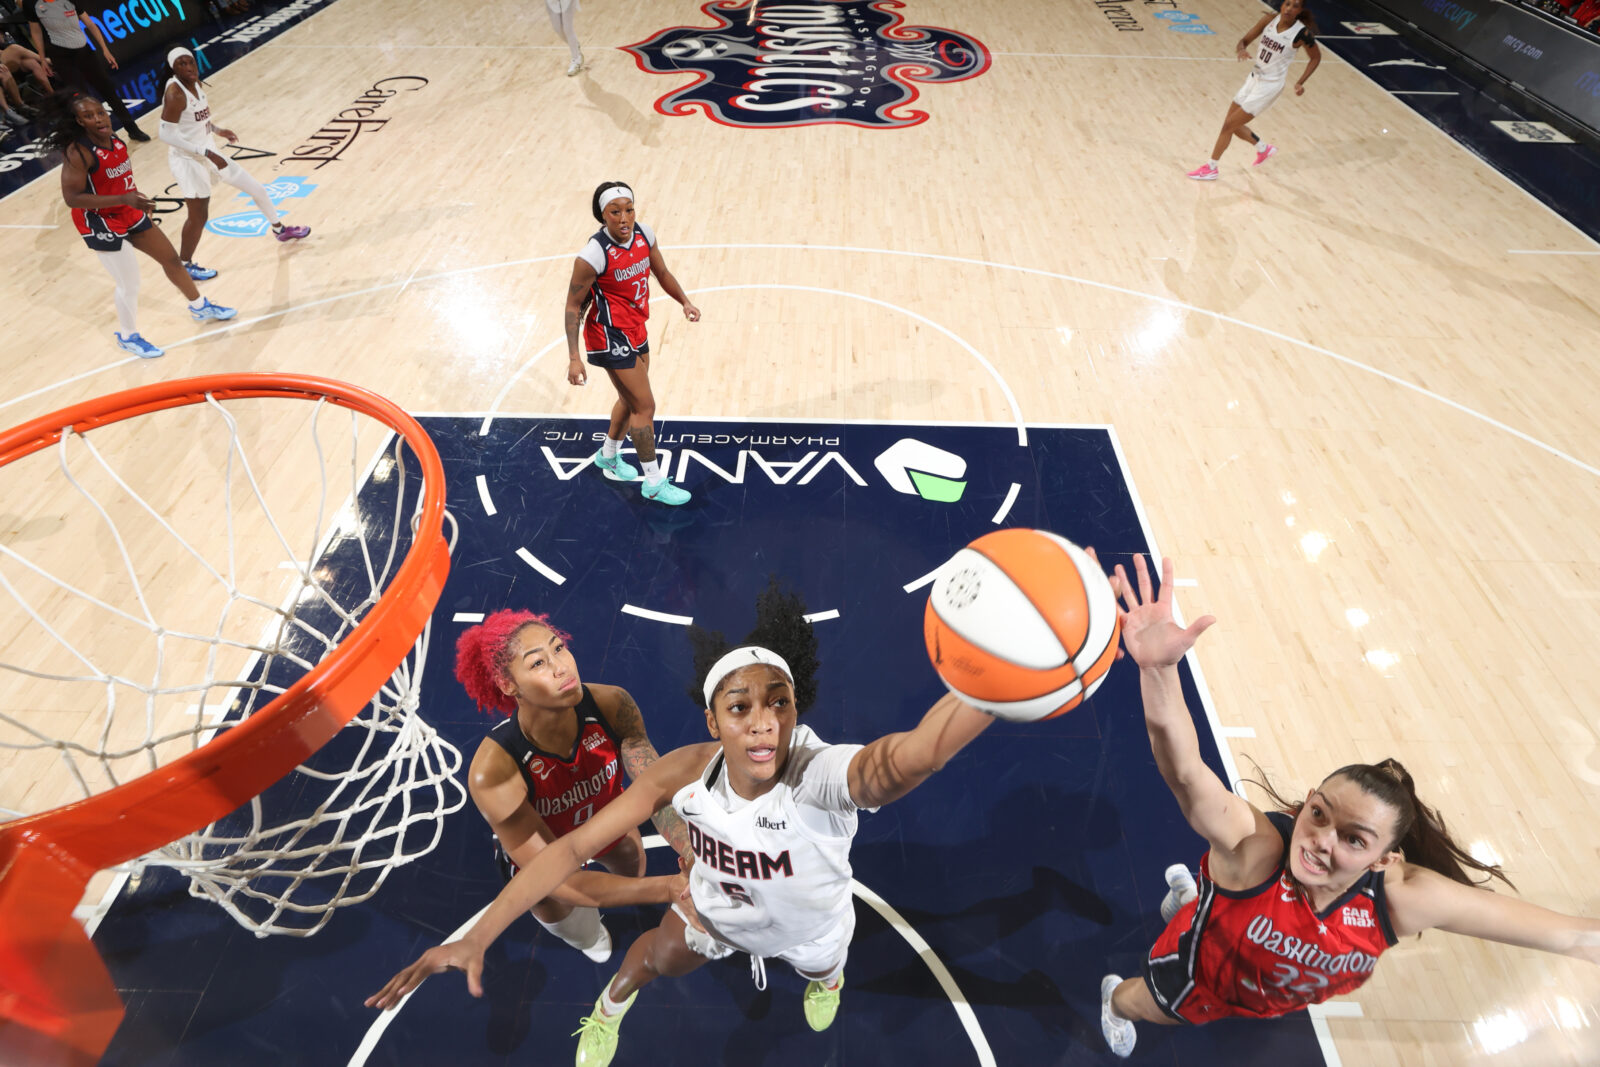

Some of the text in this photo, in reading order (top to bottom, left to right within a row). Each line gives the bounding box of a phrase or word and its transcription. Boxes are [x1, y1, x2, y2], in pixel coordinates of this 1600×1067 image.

[1261, 35, 1285, 54] DREAM
[1503, 34, 1544, 60] mrcy.com
[848, 8, 877, 107] WASHINGTON
[1259, 48, 1273, 64] 00
[123, 174, 135, 191] 12
[632, 276, 648, 300] 23
[544, 431, 840, 446] PHARMACEUTIS INC.
[582, 732, 601, 746] CAR
[585, 735, 607, 752] max
[755, 816, 787, 831] Albert
[688, 820, 794, 880] DREAM
[1342, 906, 1370, 918] CAR
[1343, 915, 1376, 928] max
[1264, 962, 1329, 993] 32
